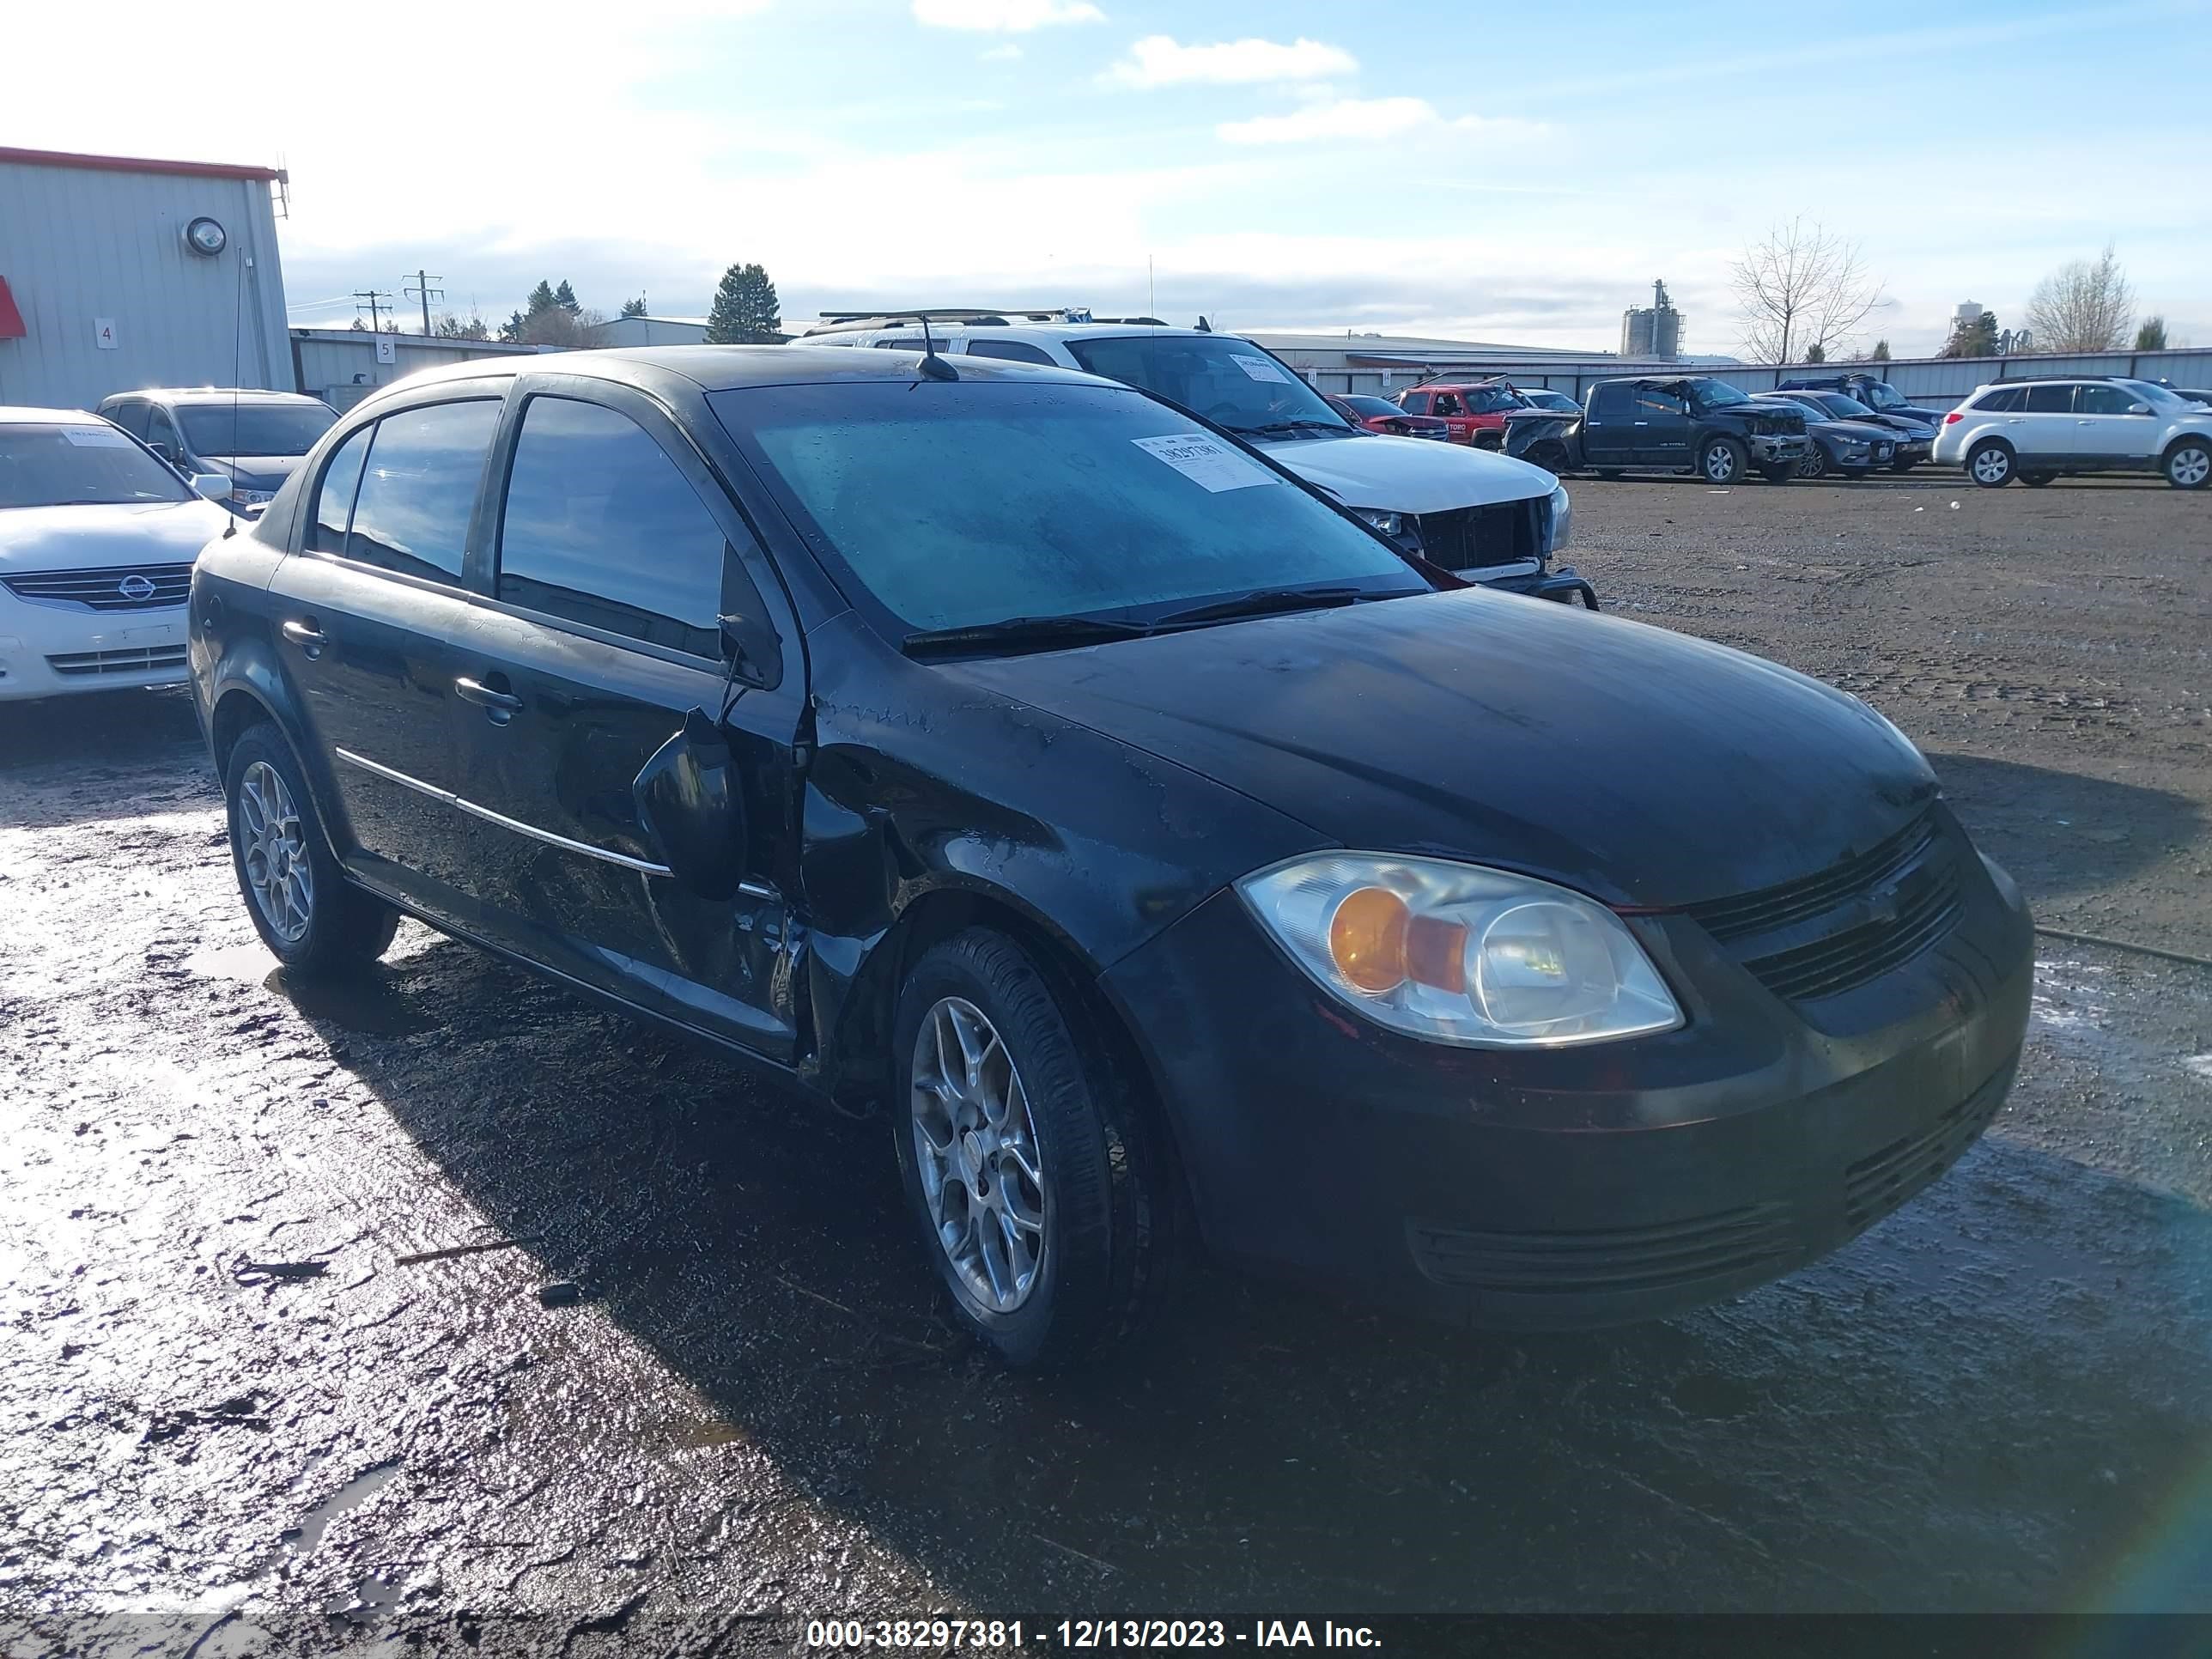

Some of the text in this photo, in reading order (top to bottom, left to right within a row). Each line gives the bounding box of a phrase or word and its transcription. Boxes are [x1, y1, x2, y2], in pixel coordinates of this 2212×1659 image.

[102, 327, 111, 340] 4
[382, 343, 389, 356] 5
[1159, 444, 1224, 460] 38297381
